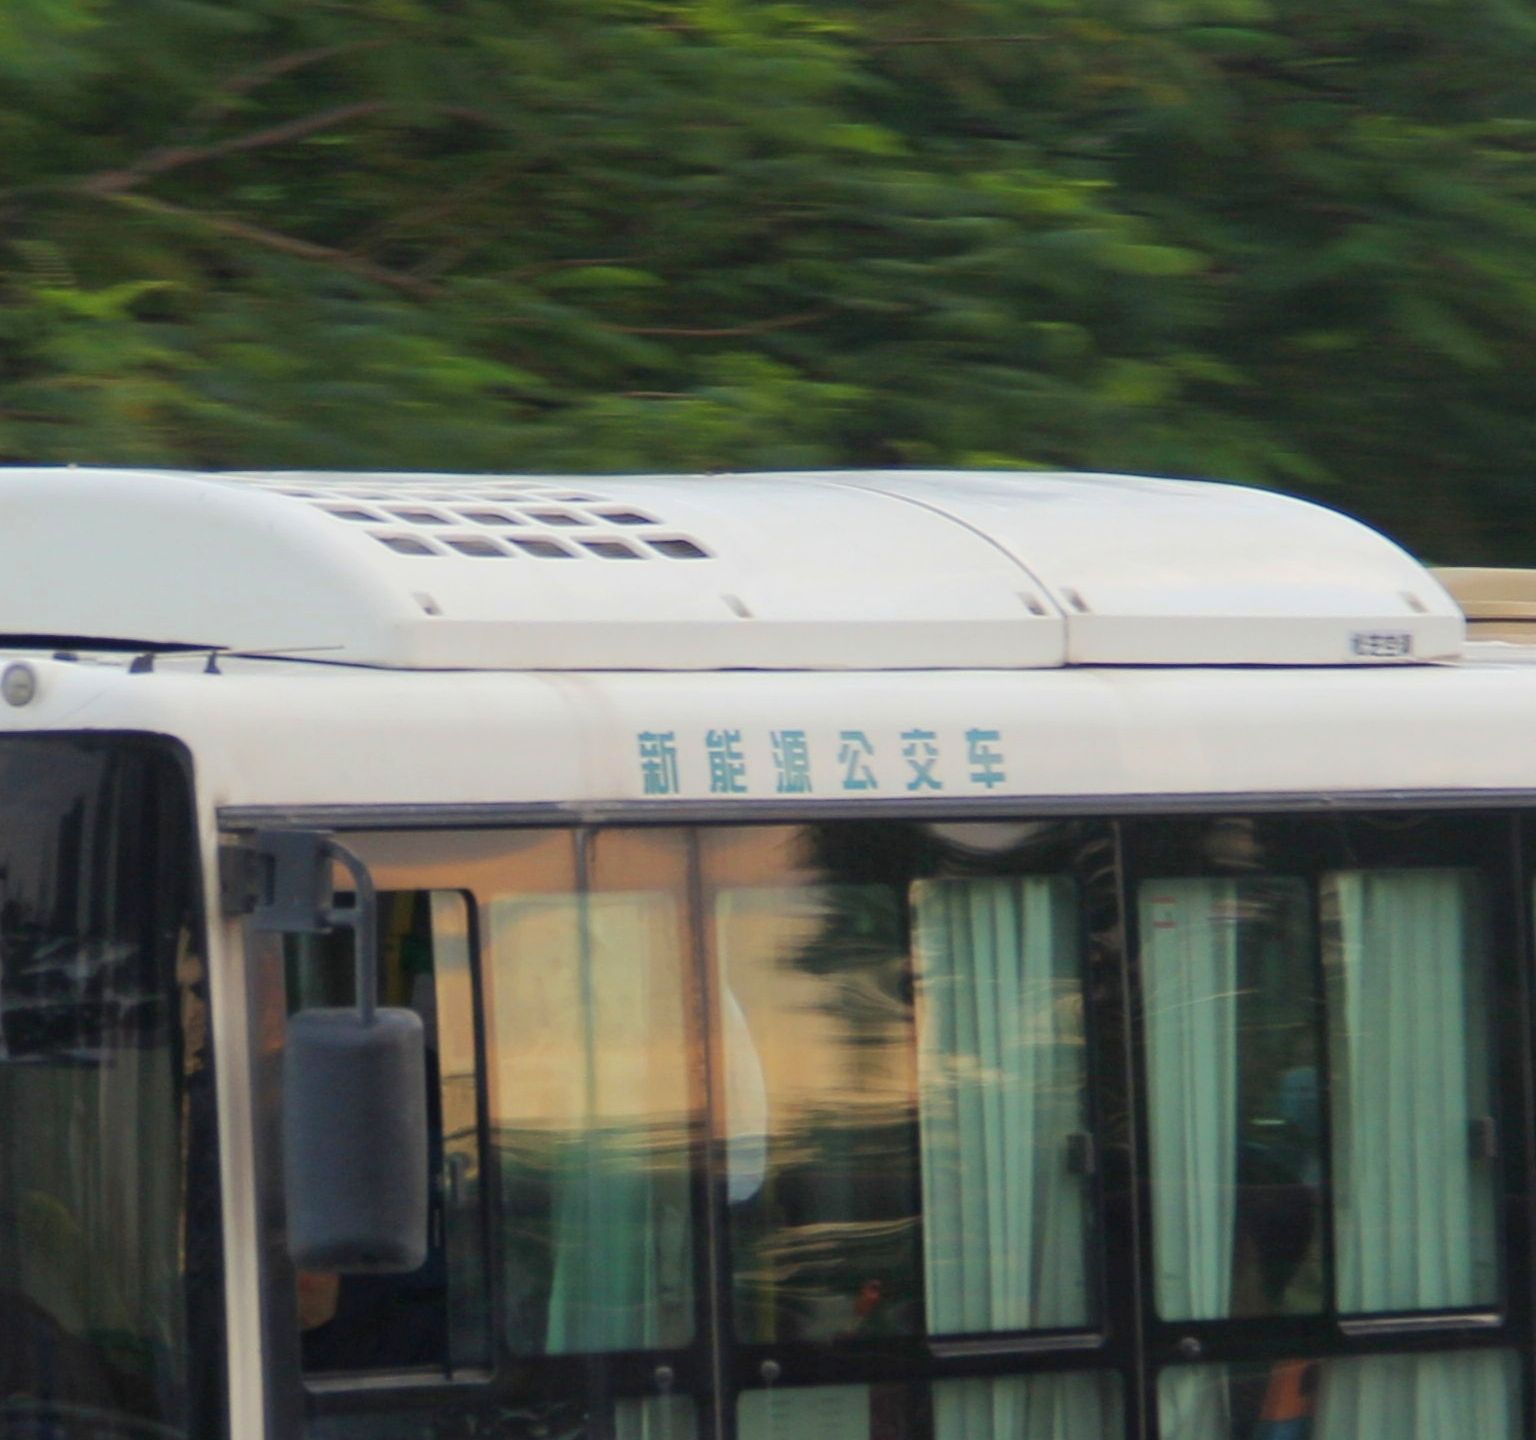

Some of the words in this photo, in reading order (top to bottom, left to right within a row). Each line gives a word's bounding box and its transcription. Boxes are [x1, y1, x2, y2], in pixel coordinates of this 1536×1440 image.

[636, 727, 1007, 796] 新能源公交车
